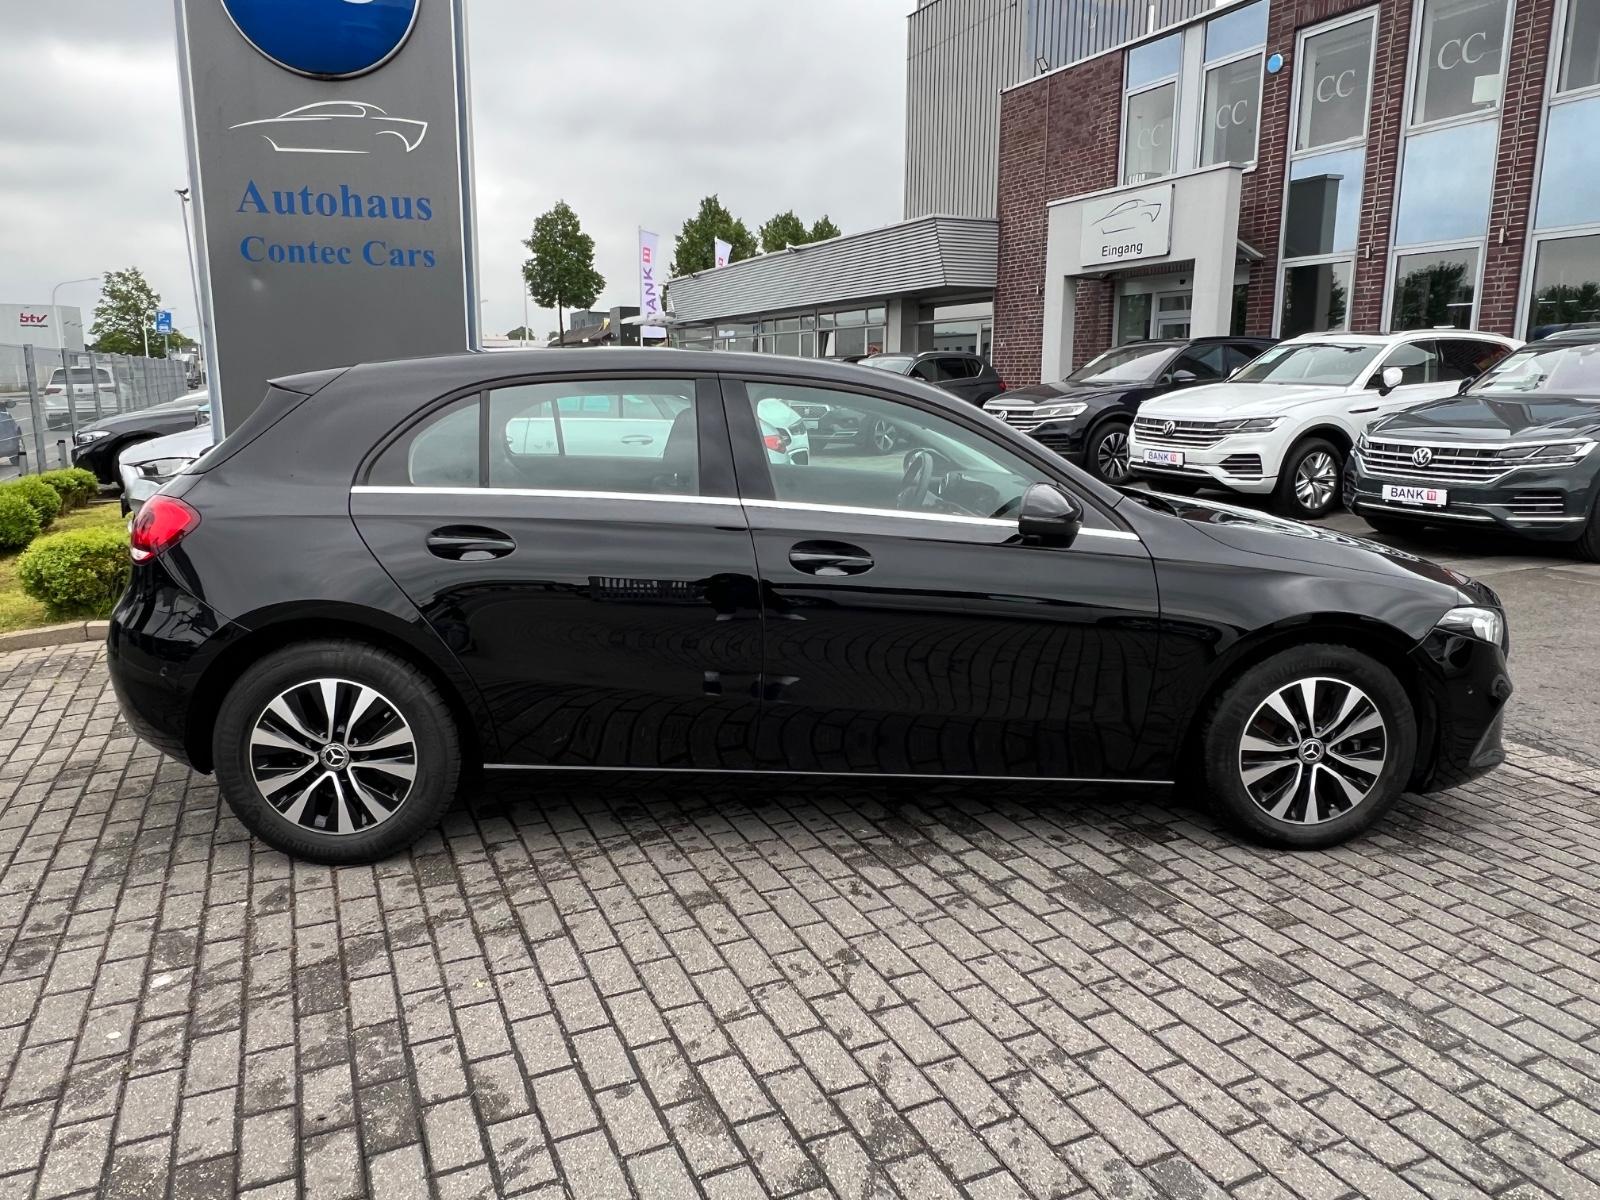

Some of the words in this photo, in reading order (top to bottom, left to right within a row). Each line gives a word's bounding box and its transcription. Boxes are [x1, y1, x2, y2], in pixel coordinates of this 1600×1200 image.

[1437, 32, 1486, 70] CC
[1316, 69, 1356, 102] CC
[1216, 99, 1248, 129] CC
[1138, 123, 1164, 150] CC
[236, 178, 432, 221] Autohaus
[240, 235, 352, 265] Contec
[362, 240, 436, 268] Cars
[1101, 243, 1143, 257] Eingang
[20, 312, 48, 323] btv
[158, 312, 166, 321] P
[1149, 451, 1169, 462] BANK
[1391, 487, 1424, 501] BANK
